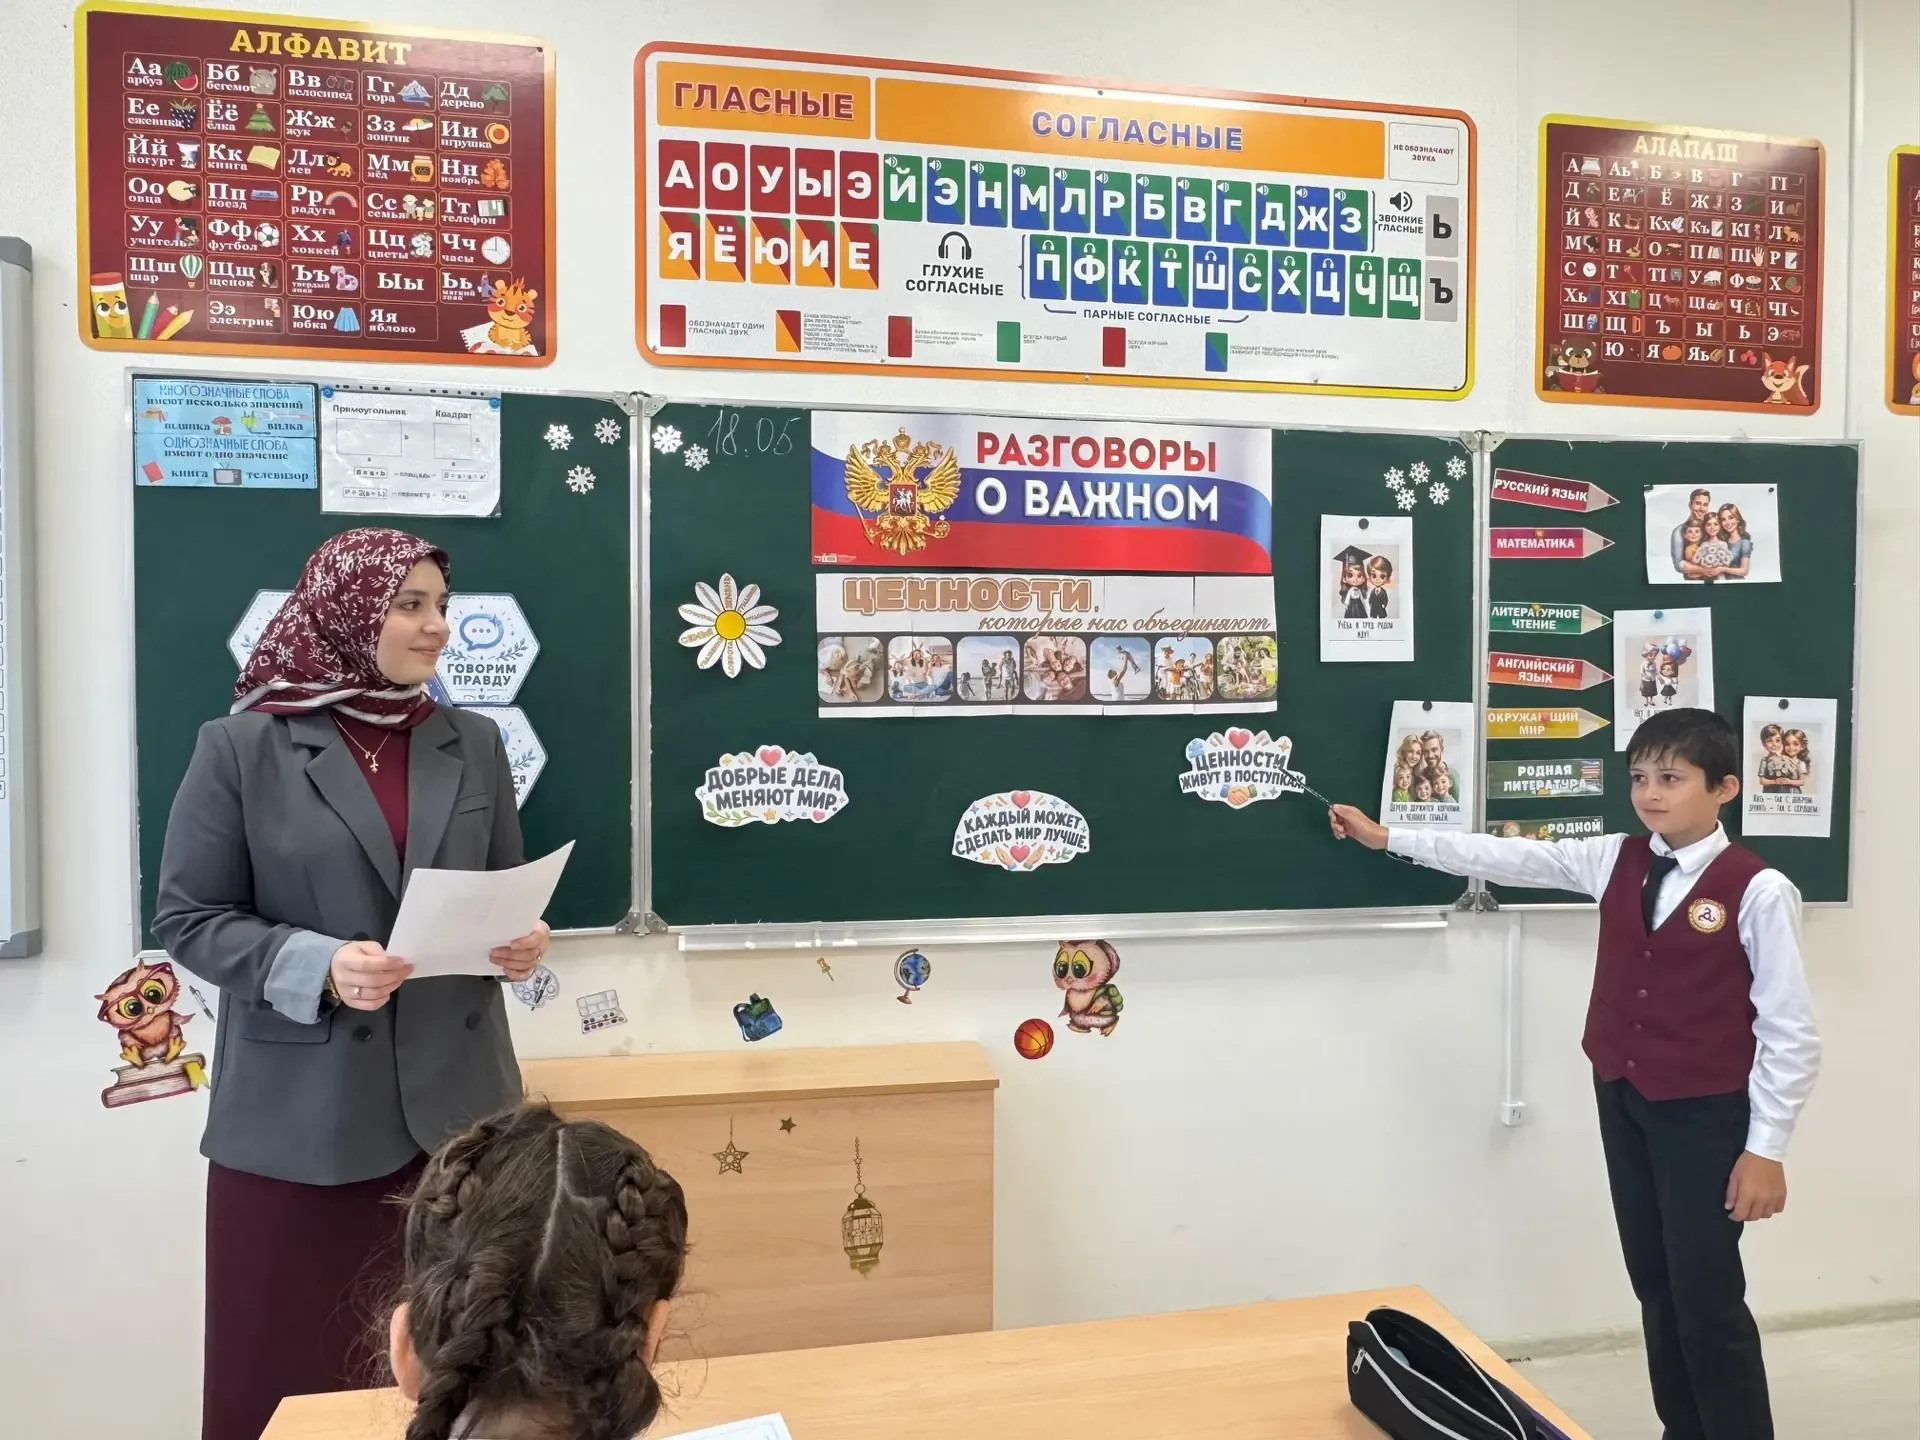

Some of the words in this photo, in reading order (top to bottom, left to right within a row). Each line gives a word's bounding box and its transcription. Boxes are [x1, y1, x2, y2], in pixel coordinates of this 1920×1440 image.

[229, 29, 412, 66] АЛФАВИТ
[128, 58, 162, 76] Аа
[207, 63, 239, 82] Бб
[128, 77, 163, 87] арбуз
[288, 70, 321, 88] Вв
[367, 76, 395, 92] Гг
[206, 82, 256, 93] бегемот
[441, 82, 469, 99] Дд
[289, 89, 353, 101] велосипед
[367, 93, 395, 103] гора
[674, 81, 854, 120] ГЛАСНЫЕ
[128, 98, 160, 116] Ее
[207, 99, 239, 122] Ёё
[441, 99, 485, 109] дерево
[128, 117, 182, 128] ежевика
[207, 121, 236, 131] ёлка
[286, 109, 336, 129] Жж
[367, 114, 396, 132] Зз
[286, 128, 311, 137] жук
[441, 121, 478, 139] Ии
[1032, 111, 1244, 151] СОГЛАСНЫЕ
[367, 133, 410, 144] зонтик
[441, 139, 492, 149] игрушка
[1404, 145, 1454, 155] ОБОЗНАЧАЮТ
[1633, 135, 1739, 162] АЛАПАШ
[128, 155, 175, 167] йогурт
[1412, 154, 1436, 162] ЗВУКА
[207, 161, 248, 171] книга
[1566, 158, 1580, 173] А
[441, 175, 480, 186] ноябрь
[664, 160, 694, 189] А
[712, 162, 738, 191] О
[757, 165, 784, 194] У
[798, 168, 832, 197] Ы
[847, 171, 872, 199] Э
[889, 167, 916, 203] Й
[934, 178, 958, 206] Э
[977, 181, 1002, 209] Н
[1019, 184, 1047, 212] М
[1060, 187, 1086, 215] Л
[1103, 190, 1125, 217] Р
[1143, 193, 1166, 220] Б
[1184, 196, 1207, 223] В
[1223, 199, 1242, 225] Г
[1261, 202, 1285, 231] Д
[1297, 205, 1328, 231] Ж
[1340, 208, 1362, 234] З
[1565, 182, 1579, 199] Д
[128, 195, 161, 205] овца
[208, 200, 247, 211] поезд
[1691, 194, 1709, 209] Ж
[1731, 197, 1742, 211] З
[291, 205, 336, 217] радуга
[1771, 200, 1784, 215] И
[441, 215, 496, 226] телефон
[1378, 214, 1424, 225] ЗВОНКИЕ
[1433, 214, 1452, 239] Ь
[1608, 212, 1620, 227] К
[1378, 224, 1424, 234] ГЛАСНЫЕ
[1768, 226, 1782, 240] Л
[208, 239, 257, 251] футбол
[668, 231, 692, 260] Я
[714, 226, 736, 263] Ё
[754, 236, 789, 265] Ю
[802, 239, 828, 269] И
[848, 241, 870, 270] Е
[1565, 236, 1581, 250] М
[368, 251, 409, 260] цветы
[442, 255, 474, 263] часы
[922, 264, 984, 280] ГЛУХИЕ
[1036, 253, 1061, 281] П
[1073, 255, 1106, 284] Ф
[1119, 258, 1142, 287] К
[1160, 261, 1182, 288] Т
[1196, 263, 1225, 290] Ш
[1239, 266, 1262, 293] С
[1277, 269, 1301, 296] Х
[1316, 271, 1340, 303] Ц
[1355, 273, 1376, 304] Ч
[1389, 275, 1418, 307] Щ
[905, 279, 1004, 296] СОГЛАСНЫЕ
[1430, 278, 1453, 303] Ъ
[209, 316, 274, 328] электрик
[1083, 309, 1135, 321] ПАРНЫЕ
[1137, 311, 1211, 325] СОГЛАСНЫЕ
[293, 320, 327, 330] юбка
[369, 324, 416, 334] яблоко
[688, 319, 742, 329] ОБОЗНАЧАЕТ
[743, 321, 765, 330] ОДИН
[688, 327, 728, 336] ГЛАСНЫЙ
[729, 328, 749, 336] ЗВУК
[160, 385, 250, 399] МНОГОЗНАЧНЫЕ
[253, 388, 289, 400] СЛОВА
[186, 399, 248, 408] несколько
[249, 400, 304, 410] значений
[332, 405, 407, 416] Прямоугольник
[435, 410, 472, 420] Квадрат
[164, 436, 249, 451] ОДНОЗНАЧНЫЕ
[251, 439, 288, 451] СЛОВА
[164, 450, 203, 458] имеют
[205, 452, 234, 460] одно
[976, 431, 1216, 473] РАЗГОВОРЫ
[171, 470, 209, 479] книга
[246, 471, 309, 483] телевизор
[1494, 478, 1549, 496] РУССКИЙ
[1551, 488, 1588, 502] ЯЗЫК
[974, 477, 1008, 517] О
[1024, 480, 1219, 523] ВАЖНОМ
[1496, 538, 1576, 549] МАТЕМАТИКА
[978, 610, 1083, 640] которые
[1087, 617, 1129, 631] нас
[1133, 607, 1271, 642] объединяют
[1511, 619, 1557, 630] ЧТЕНИЕ
[447, 663, 517, 674] ГОВОРИМ
[1496, 657, 1575, 673] АНГЛИЙСКИЙ
[452, 675, 512, 687] ПРАВДУ
[1517, 671, 1553, 684] ЯЗЫК
[1519, 725, 1546, 735] МИР
[1195, 750, 1287, 772] ЦЕННОСТИ
[1517, 764, 1573, 778] РОДНАЯ
[707, 767, 787, 793] ДОБРЫЕ
[791, 767, 841, 791] ДЕЛА
[1180, 771, 1221, 791] ЖИВУТ
[1223, 770, 1232, 783] В
[1503, 779, 1588, 792] ЛИТЕРАТУРА
[715, 788, 794, 811] МЕНЯЮТ
[963, 807, 1031, 834] КАЖДЫЙ
[1034, 810, 1083, 829] МОЖЕТ
[1547, 818, 1601, 835] РОДНОЙ
[955, 828, 1012, 855] СДЕЛАТЬ
[1015, 827, 1041, 840] МИР
